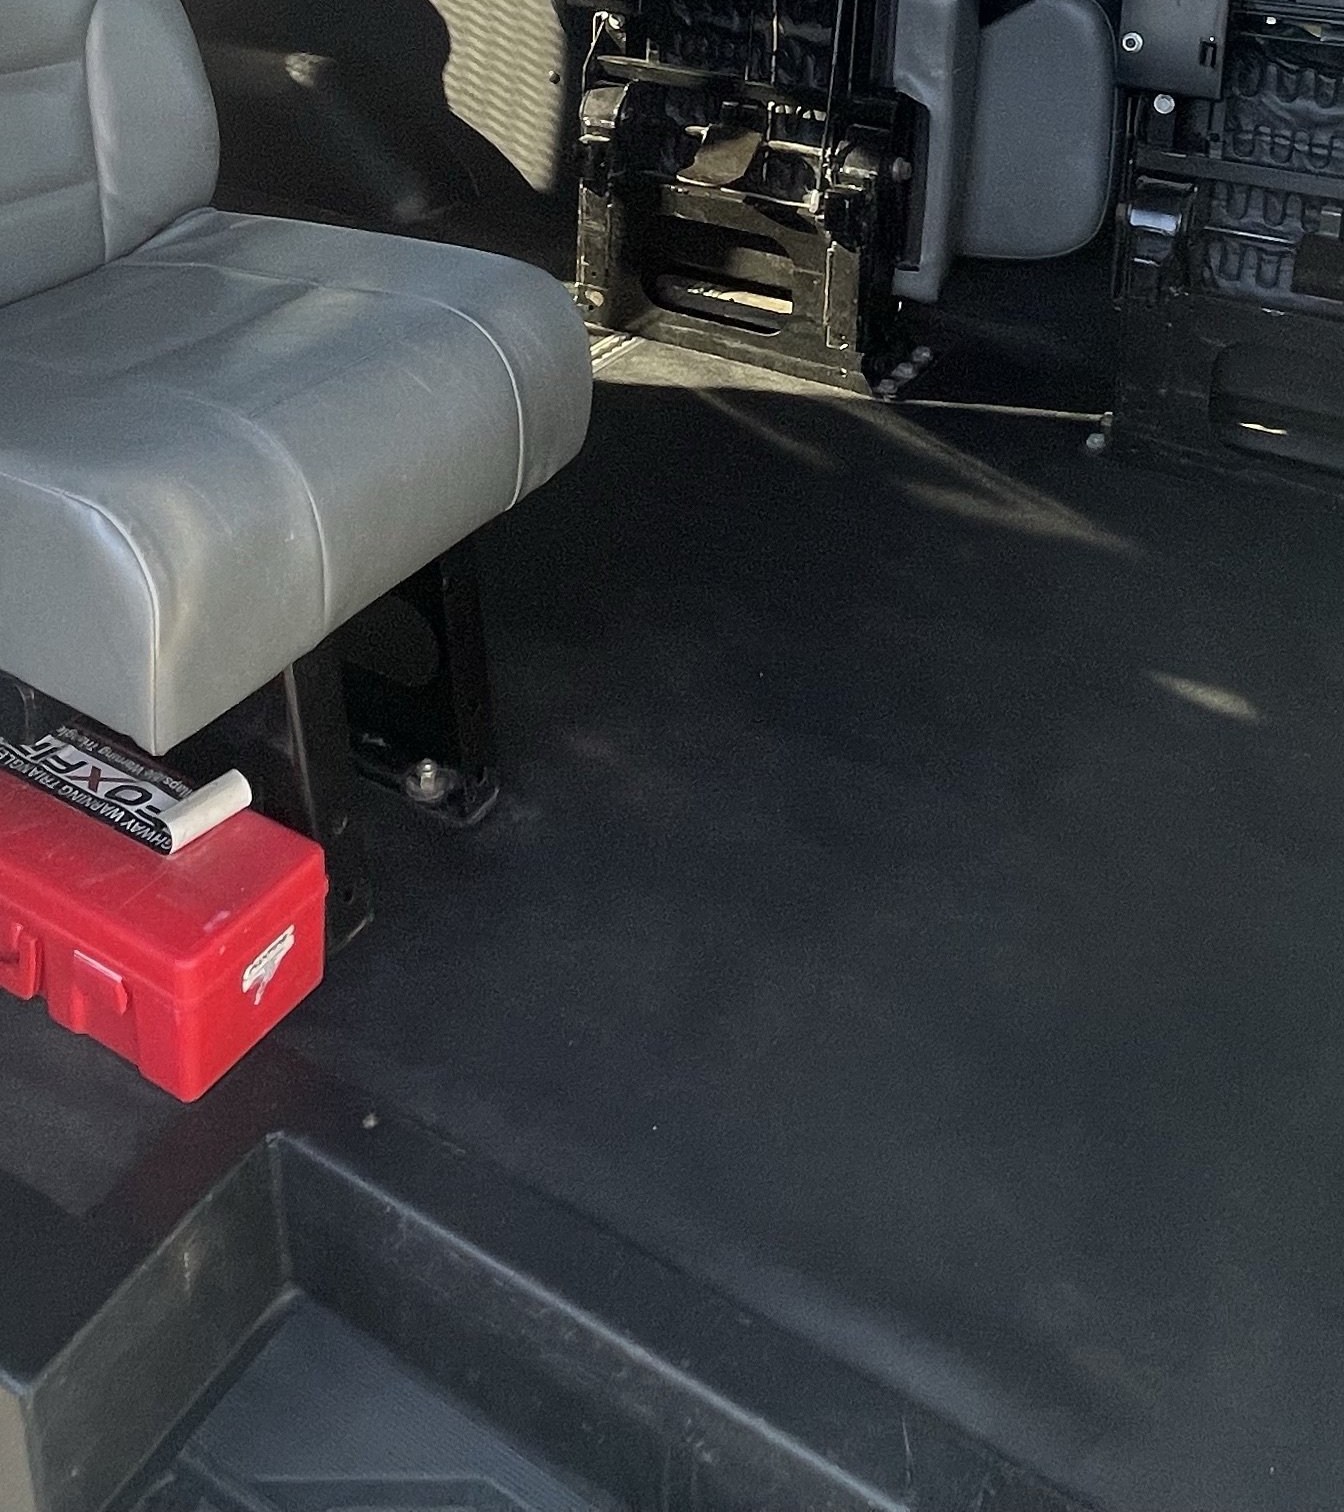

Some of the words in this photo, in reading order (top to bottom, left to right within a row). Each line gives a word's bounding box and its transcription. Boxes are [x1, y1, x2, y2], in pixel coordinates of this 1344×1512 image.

[97, 745, 145, 776] Warning
[58, 784, 125, 822] WARNING
[119, 818, 172, 850] GHWAY
